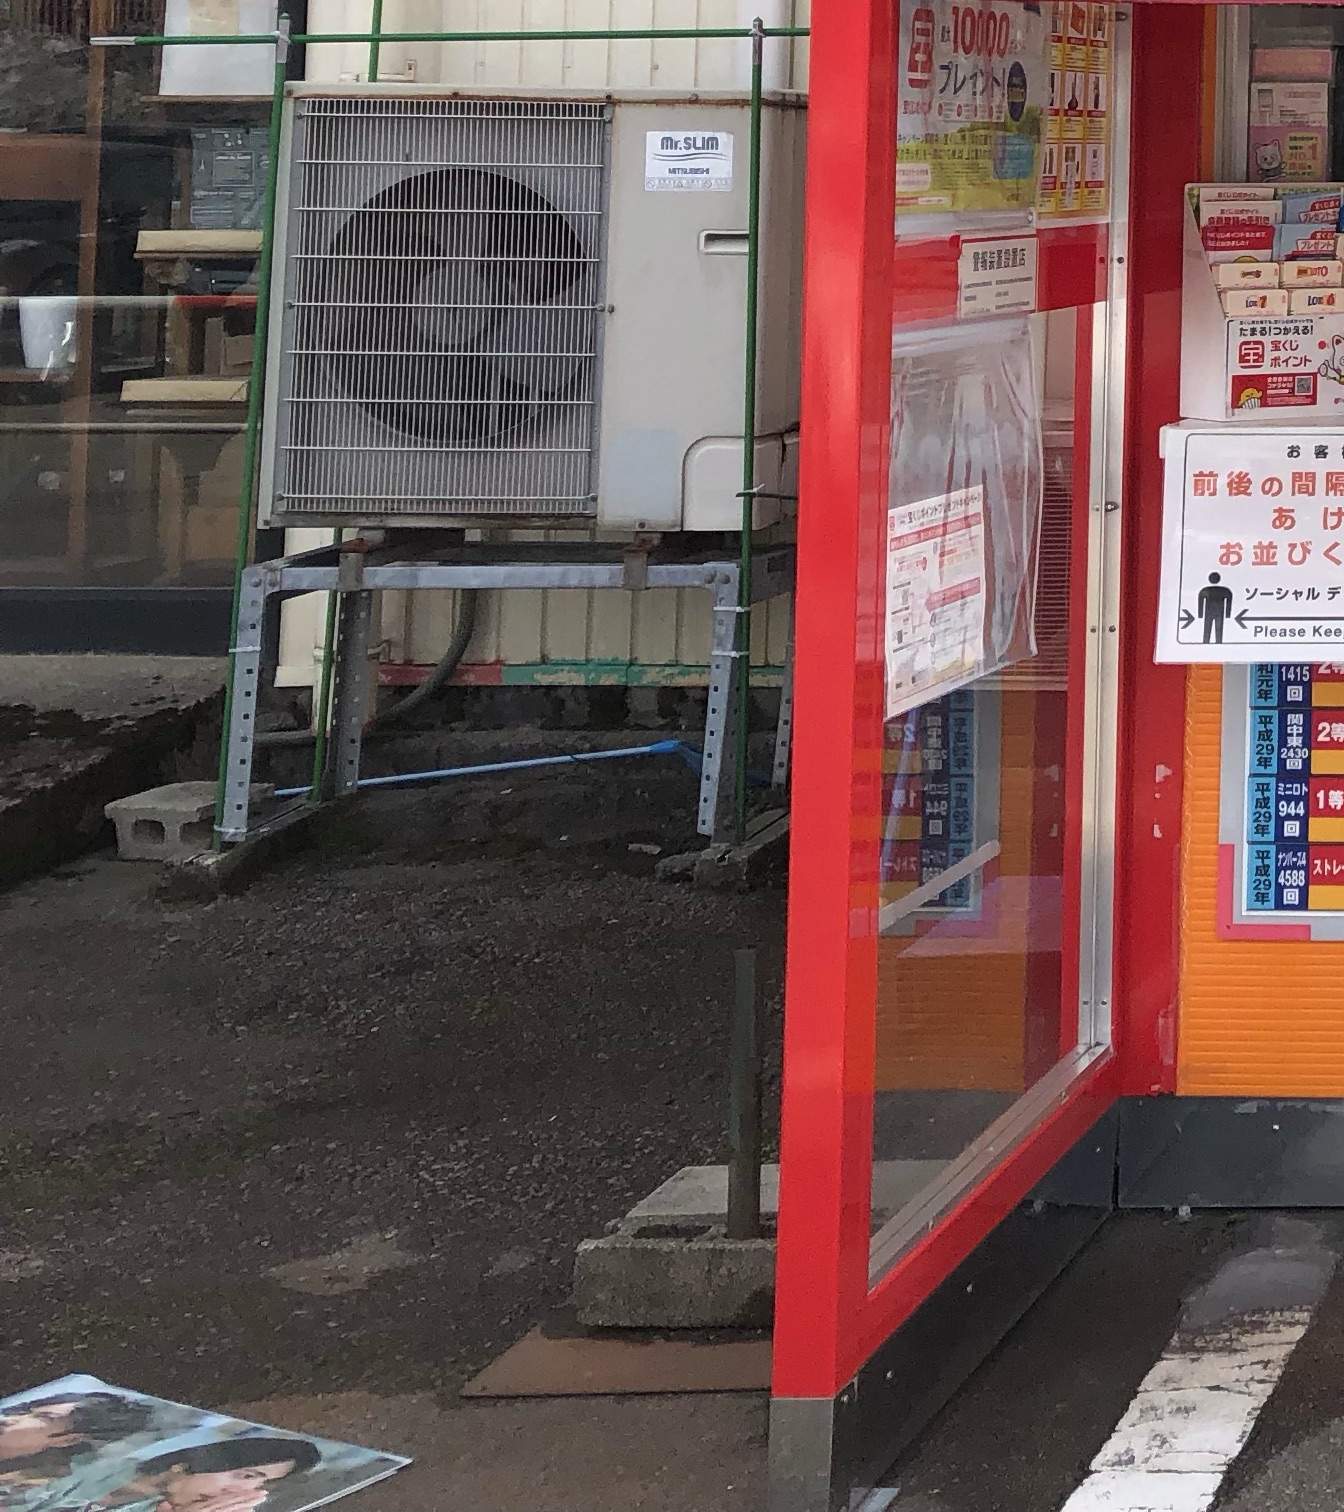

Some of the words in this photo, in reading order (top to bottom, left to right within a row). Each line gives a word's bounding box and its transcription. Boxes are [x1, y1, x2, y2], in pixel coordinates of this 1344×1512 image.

[661, 136, 719, 150] Mr.SLIM
[1271, 340, 1299, 352] 宝くじ
[1270, 356, 1312, 368] ポイント
[1245, 587, 1320, 601] ソーシャル
[1253, 626, 1306, 638] Please
[1287, 686, 1302, 701] 回
[1256, 714, 1274, 769] 平成29年
[1281, 748, 1308, 759] 2430
[1278, 782, 1308, 795] ミニロト
[1316, 790, 1344, 810] 1等
[1253, 782, 1272, 838] 平成29年
[1278, 801, 1305, 816] 944
[1284, 821, 1299, 837] 回
[1253, 850, 1271, 904] 平成29年
[1278, 871, 1305, 887] 4588
[1284, 889, 1299, 905] 回
